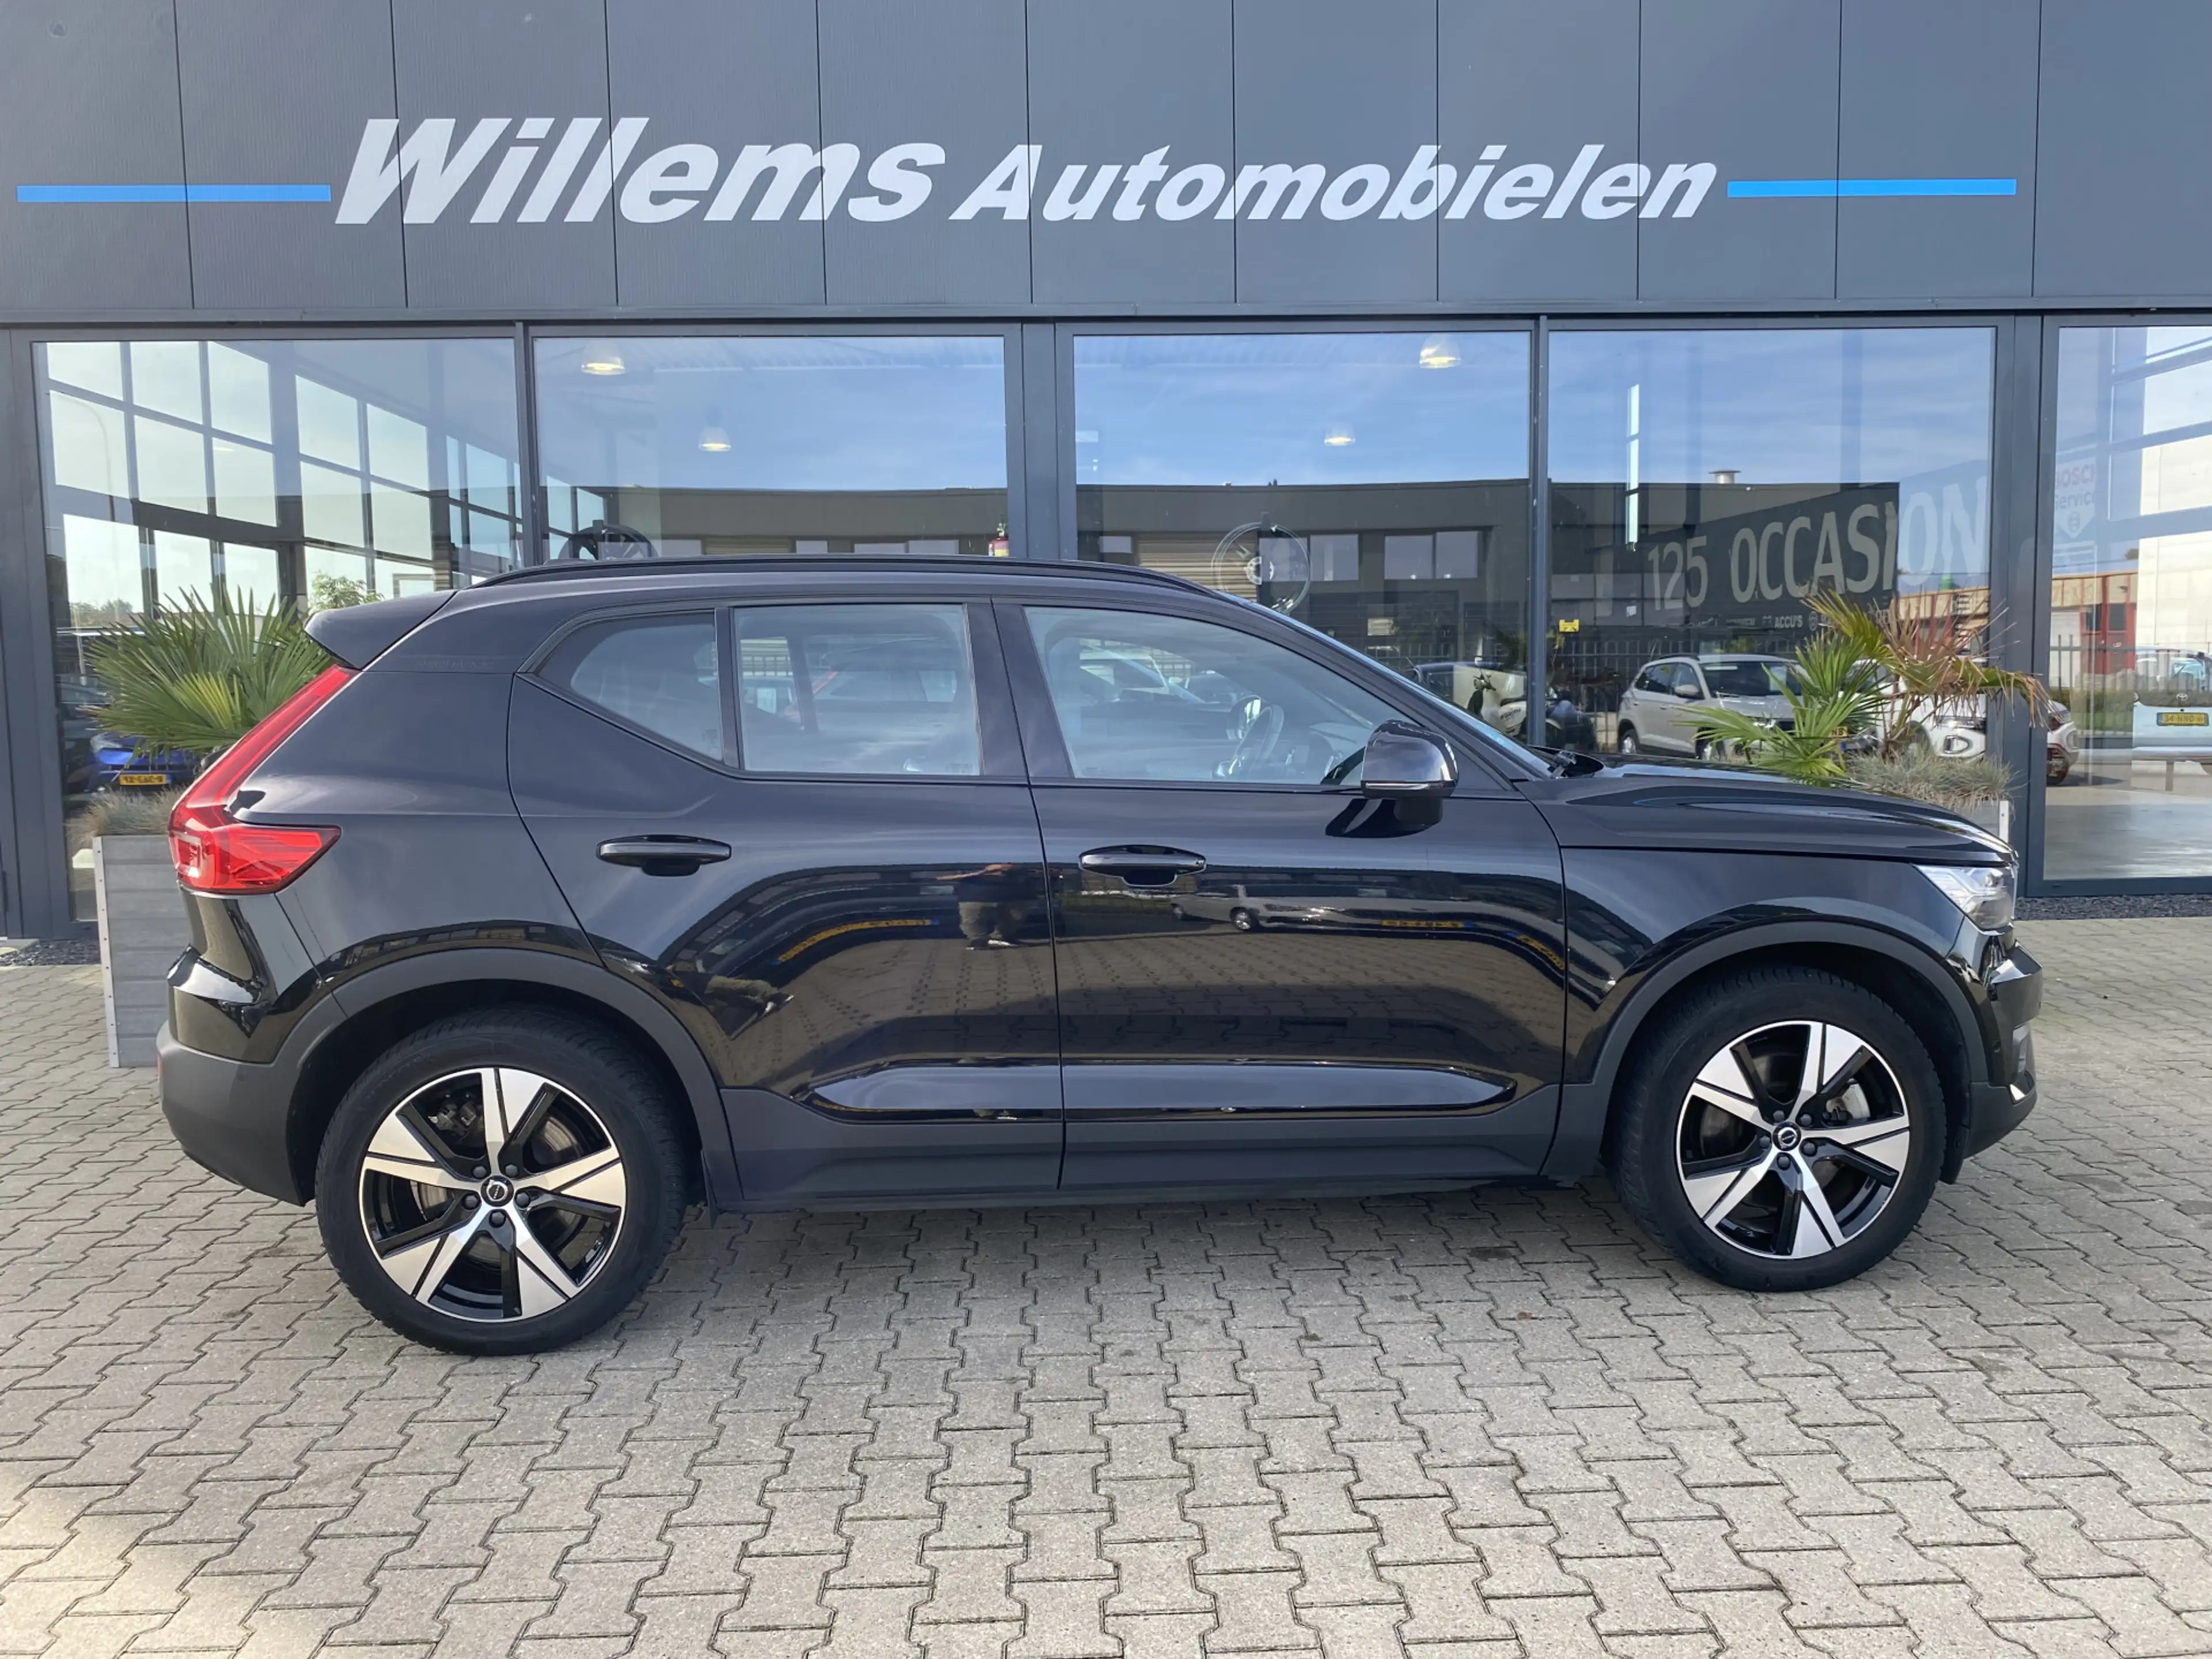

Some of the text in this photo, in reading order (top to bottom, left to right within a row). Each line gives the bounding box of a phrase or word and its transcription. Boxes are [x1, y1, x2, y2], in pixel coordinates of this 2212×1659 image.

[335, 117, 1717, 224] Willems Automobielen
[1647, 535, 1708, 611] 125
